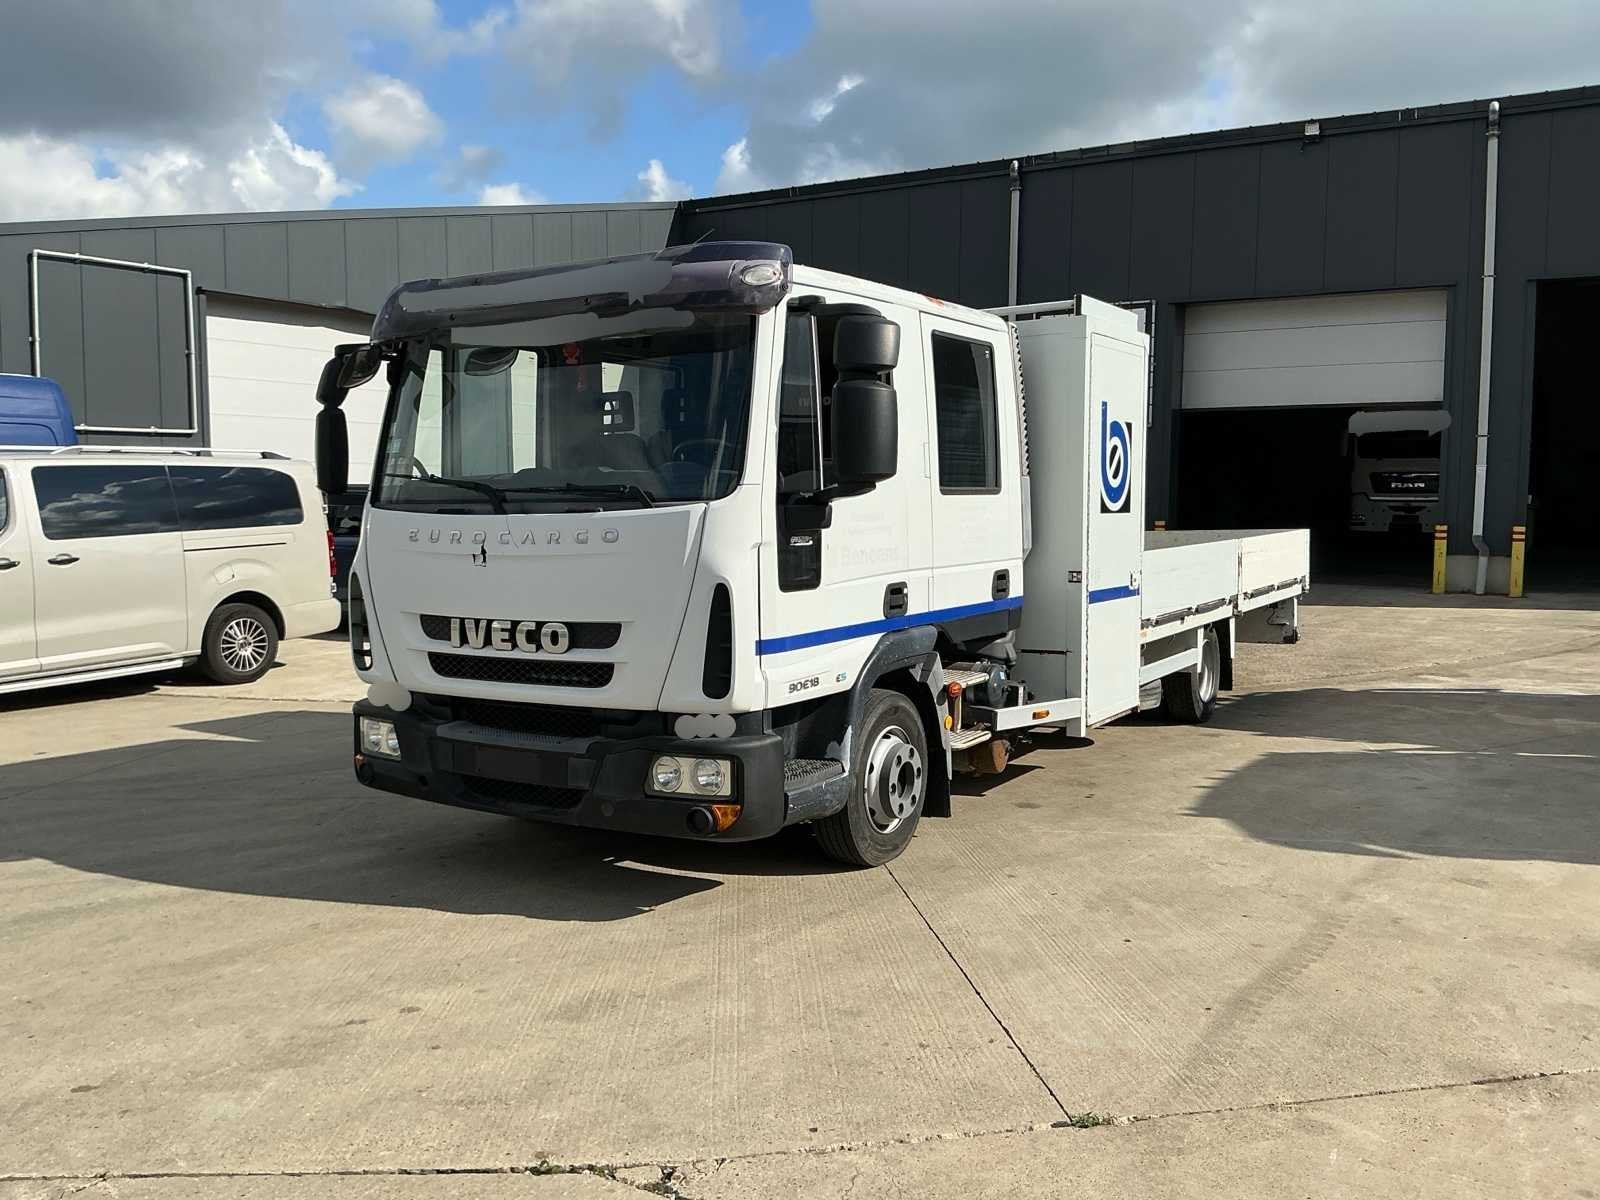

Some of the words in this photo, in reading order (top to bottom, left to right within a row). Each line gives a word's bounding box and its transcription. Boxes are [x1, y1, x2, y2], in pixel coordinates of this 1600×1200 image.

[407, 527, 621, 546] EUROCARGO
[449, 617, 571, 654] IVECO
[788, 676, 820, 694] 90E18
